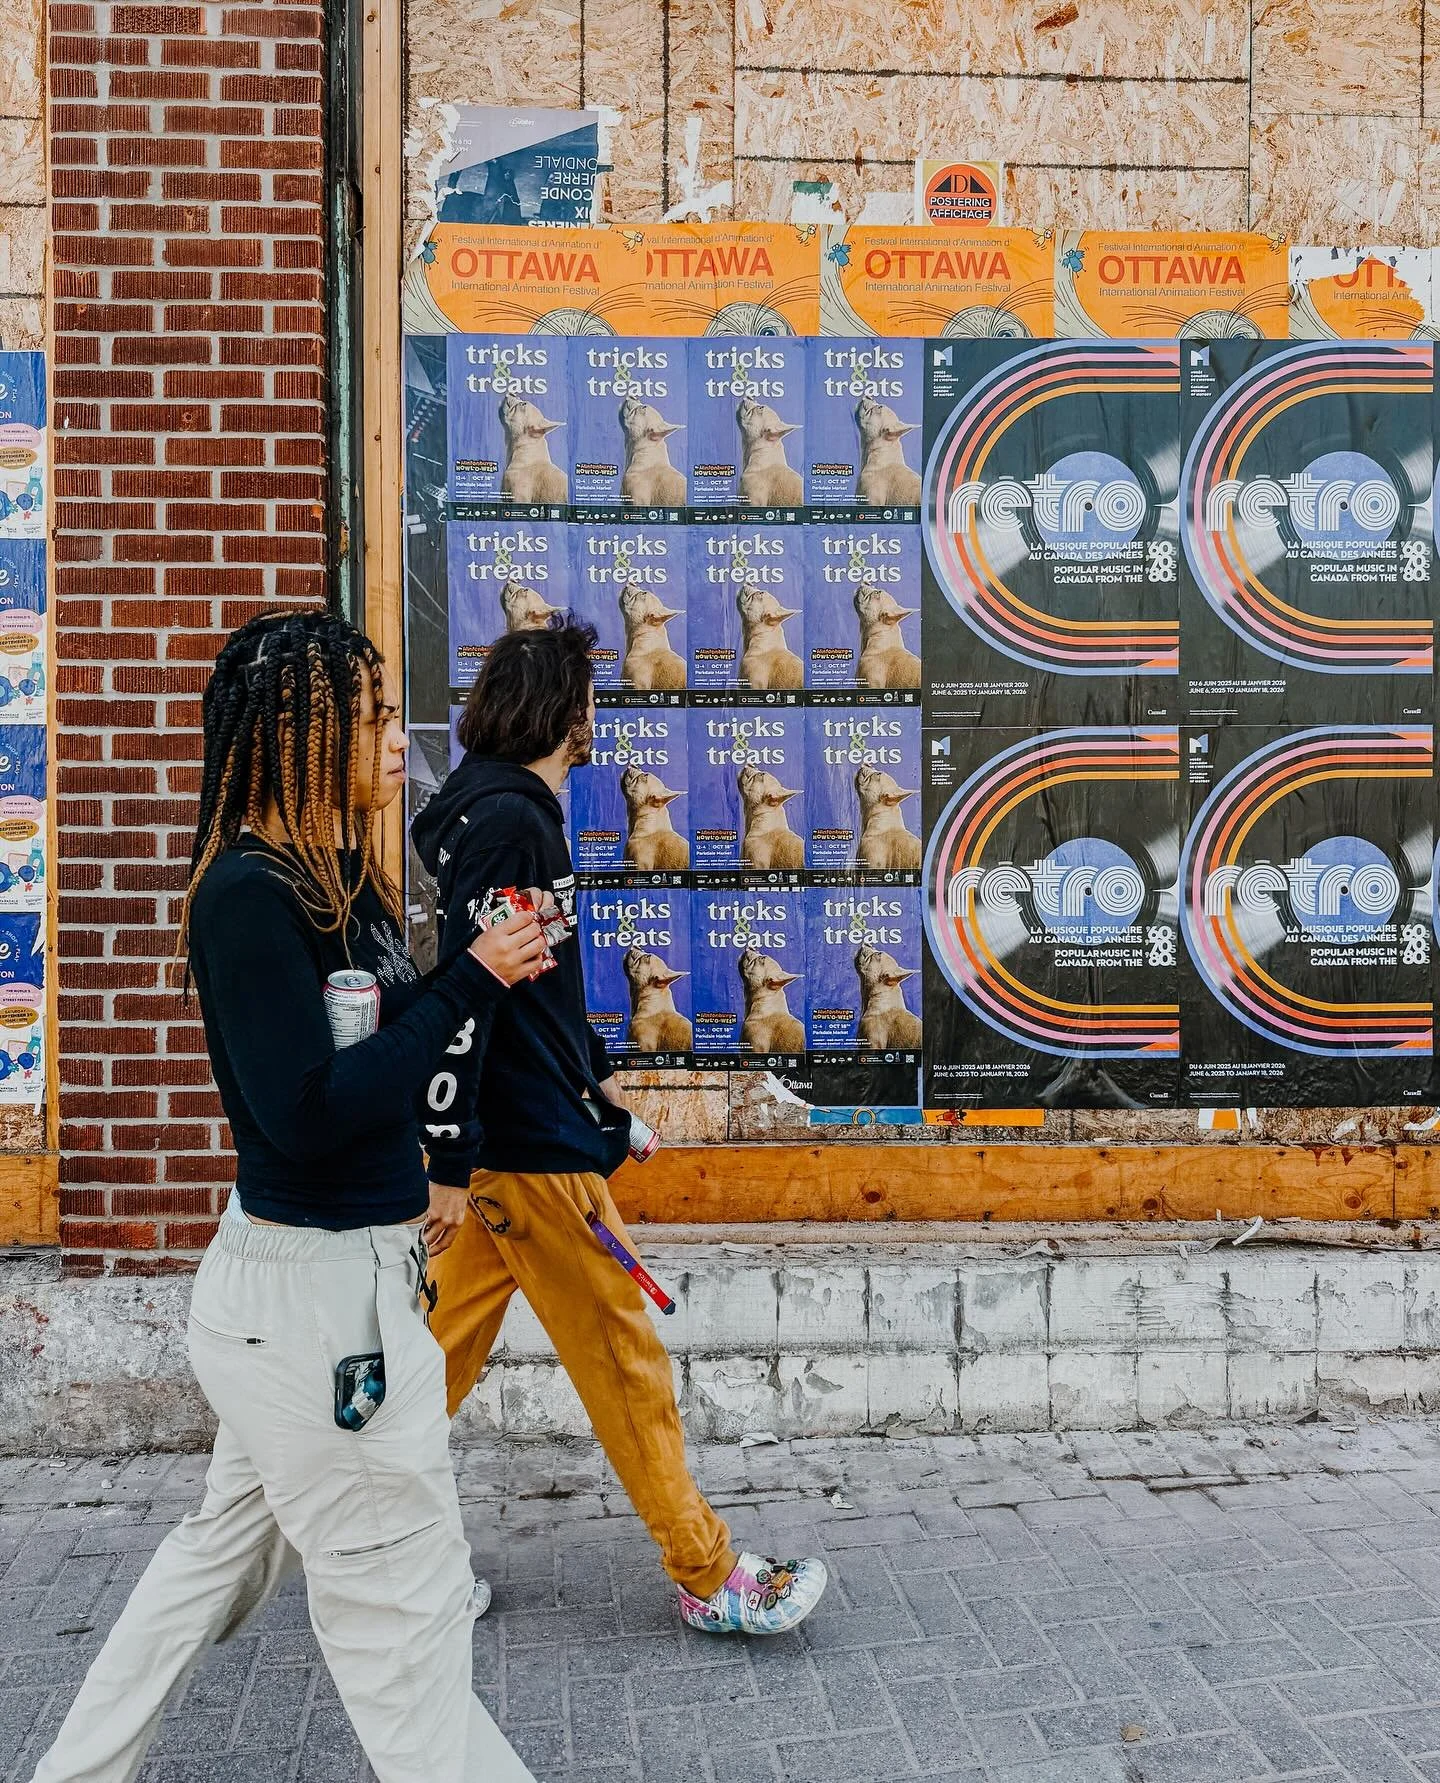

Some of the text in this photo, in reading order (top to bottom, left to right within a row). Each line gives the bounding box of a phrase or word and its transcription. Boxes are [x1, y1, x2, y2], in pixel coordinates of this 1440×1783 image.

[540, 187, 593, 200] CONDE
[930, 197, 990, 207] POSTERING
[930, 209, 990, 219] AFFICHAGE
[452, 234, 484, 244] Festival
[487, 236, 540, 247] International
[662, 235, 714, 245] International
[864, 237, 898, 246] Festival
[900, 237, 951, 246] International
[1098, 242, 1131, 251] Festival
[1133, 242, 1185, 252] International
[451, 248, 600, 283] OTTAWA
[646, 247, 774, 278] TTAWA
[865, 249, 1011, 280] OTTAWA
[1098, 255, 1246, 284] OTTAWA
[451, 280, 600, 296] International Animation Festival
[688, 279, 735, 290] Animation
[737, 278, 774, 289] Festival
[865, 282, 1011, 292] International Animation Festival
[1099, 287, 1245, 297] International Animation Festival
[1333, 291, 1390, 300] International
[467, 343, 546, 366] tricks
[588, 346, 667, 368] tricks
[705, 346, 785, 369] tricks
[824, 346, 904, 368] tricks
[468, 373, 547, 394] treats
[588, 376, 667, 397] treats
[706, 376, 784, 397] treats
[824, 376, 903, 397] treats
[468, 530, 548, 552] tricks
[587, 533, 667, 556] tricks
[705, 533, 785, 556] tricks
[822, 532, 902, 555] tricks
[1045, 542, 1087, 550] MUSIQUE
[1090, 541, 1143, 549] POPULAIRE
[1301, 541, 1343, 549] MUSIQUE
[1344, 541, 1398, 549] POPULAIRE
[1044, 552, 1082, 560] CANADA
[1105, 550, 1143, 559] ANNÉES
[1300, 550, 1338, 558] CANADA
[1359, 549, 1398, 558] ANNÉES
[469, 560, 548, 580] treats
[588, 563, 667, 583] treats
[706, 563, 784, 583] treats
[823, 562, 902, 583] treats
[706, 715, 786, 738] tricks
[822, 715, 902, 738] tricks
[590, 746, 668, 766] treats
[707, 744, 786, 765] treats
[824, 744, 902, 765] treats
[591, 898, 671, 920] tricks
[708, 899, 787, 922] tricks
[823, 895, 902, 918] tricks
[592, 927, 671, 947] treats
[708, 928, 786, 948] treats
[824, 924, 902, 945] treats
[1045, 926, 1087, 934] MUSIQUE
[1089, 926, 1142, 934] POPULAIRE
[1300, 934, 1339, 942] CANADA
[1359, 933, 1397, 942] ANNÉES
[1301, 925, 1343, 933] MUSIQUE
[1344, 924, 1398, 932] POPULAIRE
[1044, 936, 1083, 944] CANADA
[1104, 934, 1142, 943] ANNÉES
[780, 1074, 813, 1090] Ottawa
